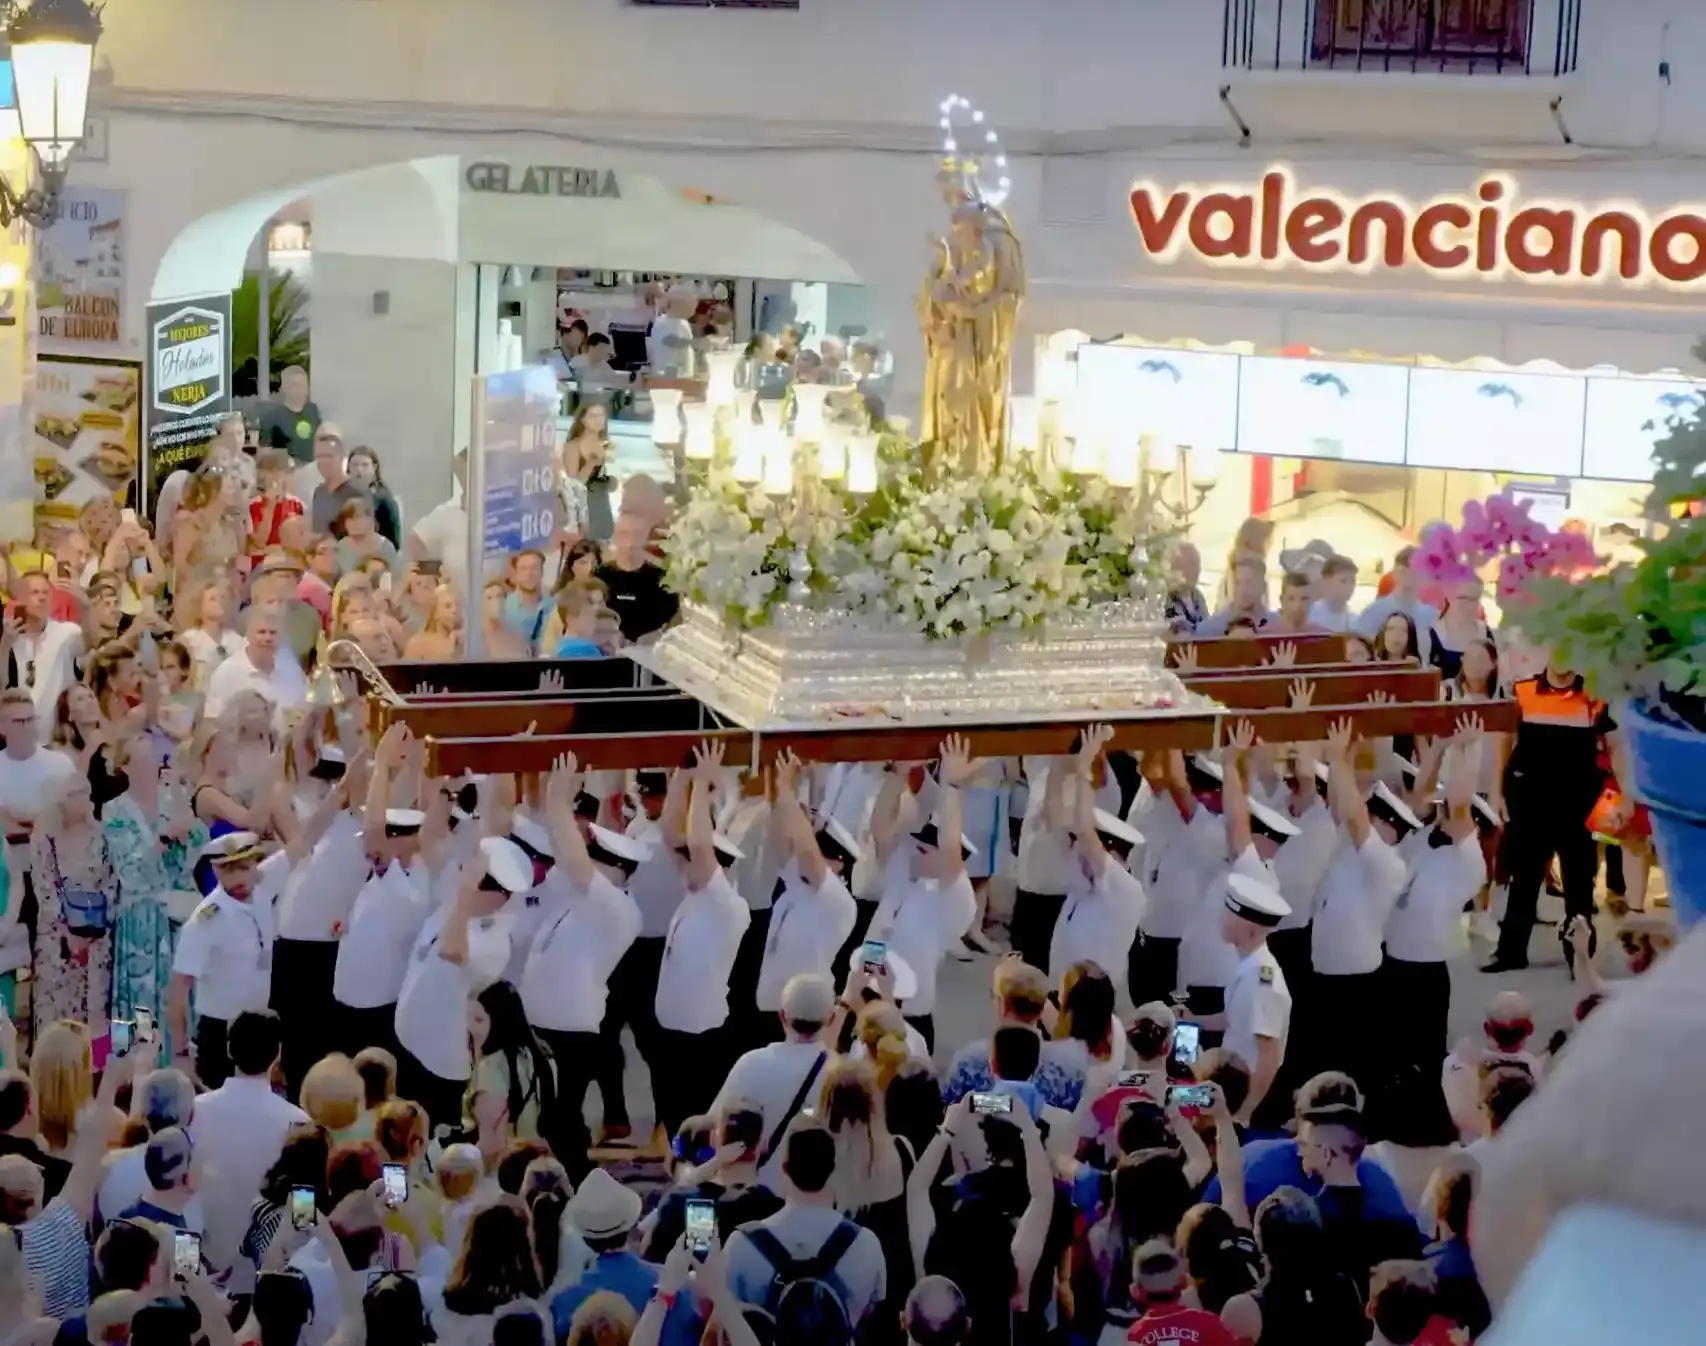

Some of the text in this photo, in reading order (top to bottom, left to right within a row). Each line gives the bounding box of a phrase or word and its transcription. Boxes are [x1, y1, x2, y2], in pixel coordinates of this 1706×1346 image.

[466, 161, 621, 199] GELATERIA
[1130, 171, 1706, 281] valenciano
[40, 315, 56, 336] DE
[170, 324, 209, 342] MEJORES
[172, 383, 206, 403] NERJA
